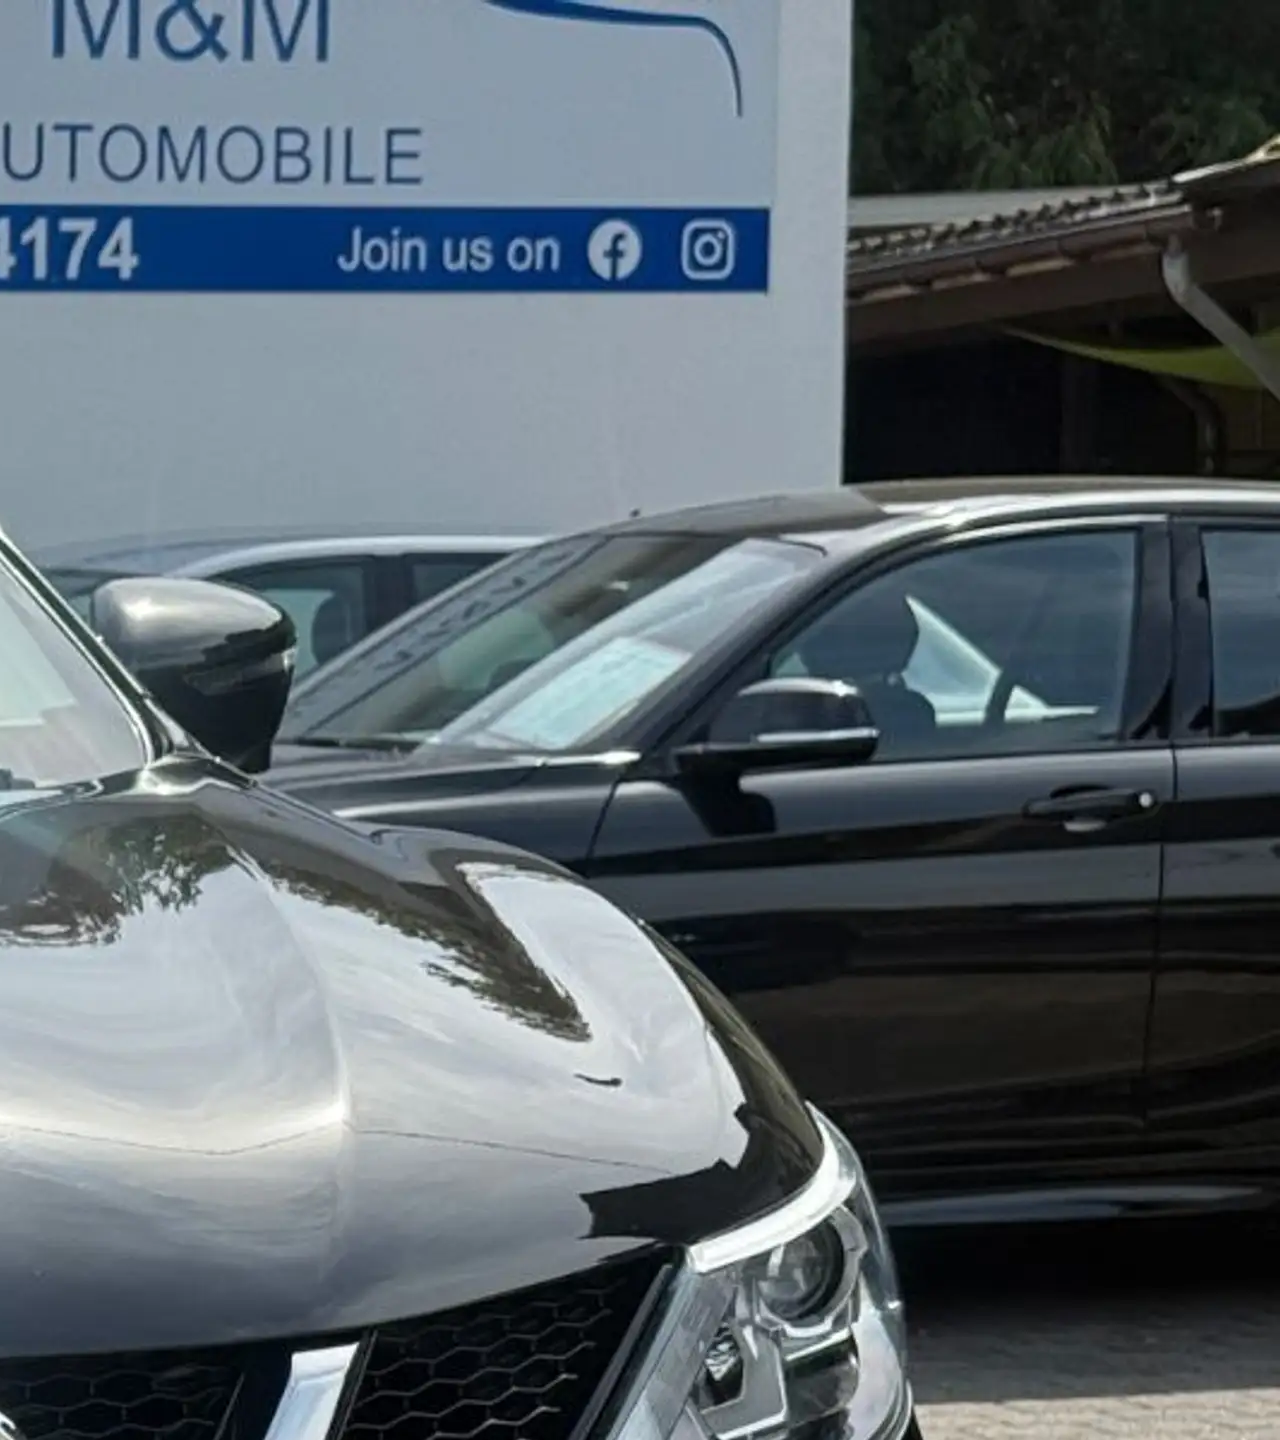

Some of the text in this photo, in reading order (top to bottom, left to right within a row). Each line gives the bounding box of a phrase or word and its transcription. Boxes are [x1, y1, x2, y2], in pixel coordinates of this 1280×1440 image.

[51, 0, 330, 62] M&M
[337, 226, 561, 273] Join us on
